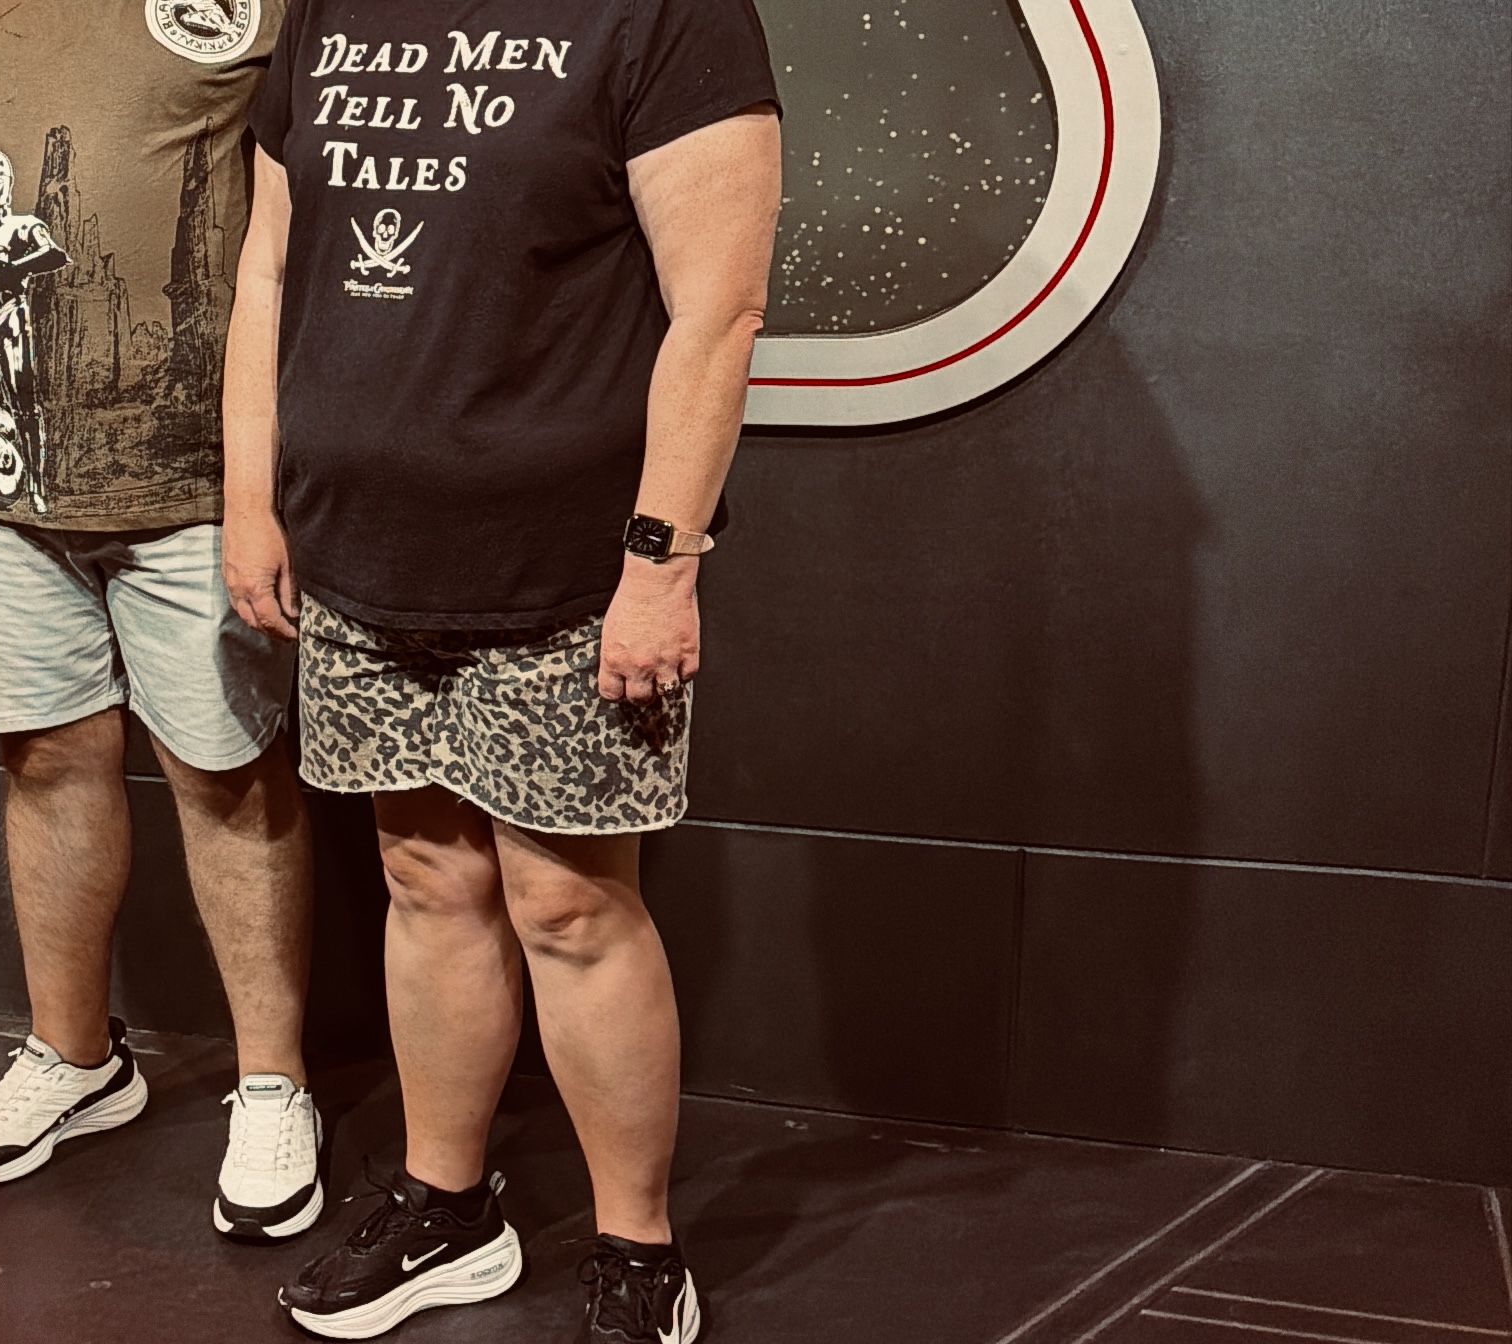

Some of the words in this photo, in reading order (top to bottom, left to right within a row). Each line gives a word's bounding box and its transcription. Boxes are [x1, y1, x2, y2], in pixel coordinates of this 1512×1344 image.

[310, 33, 429, 77] DEAD
[443, 30, 572, 79] MEN
[313, 85, 422, 130] TELL
[443, 83, 516, 135] NO
[322, 141, 468, 192] TALES
